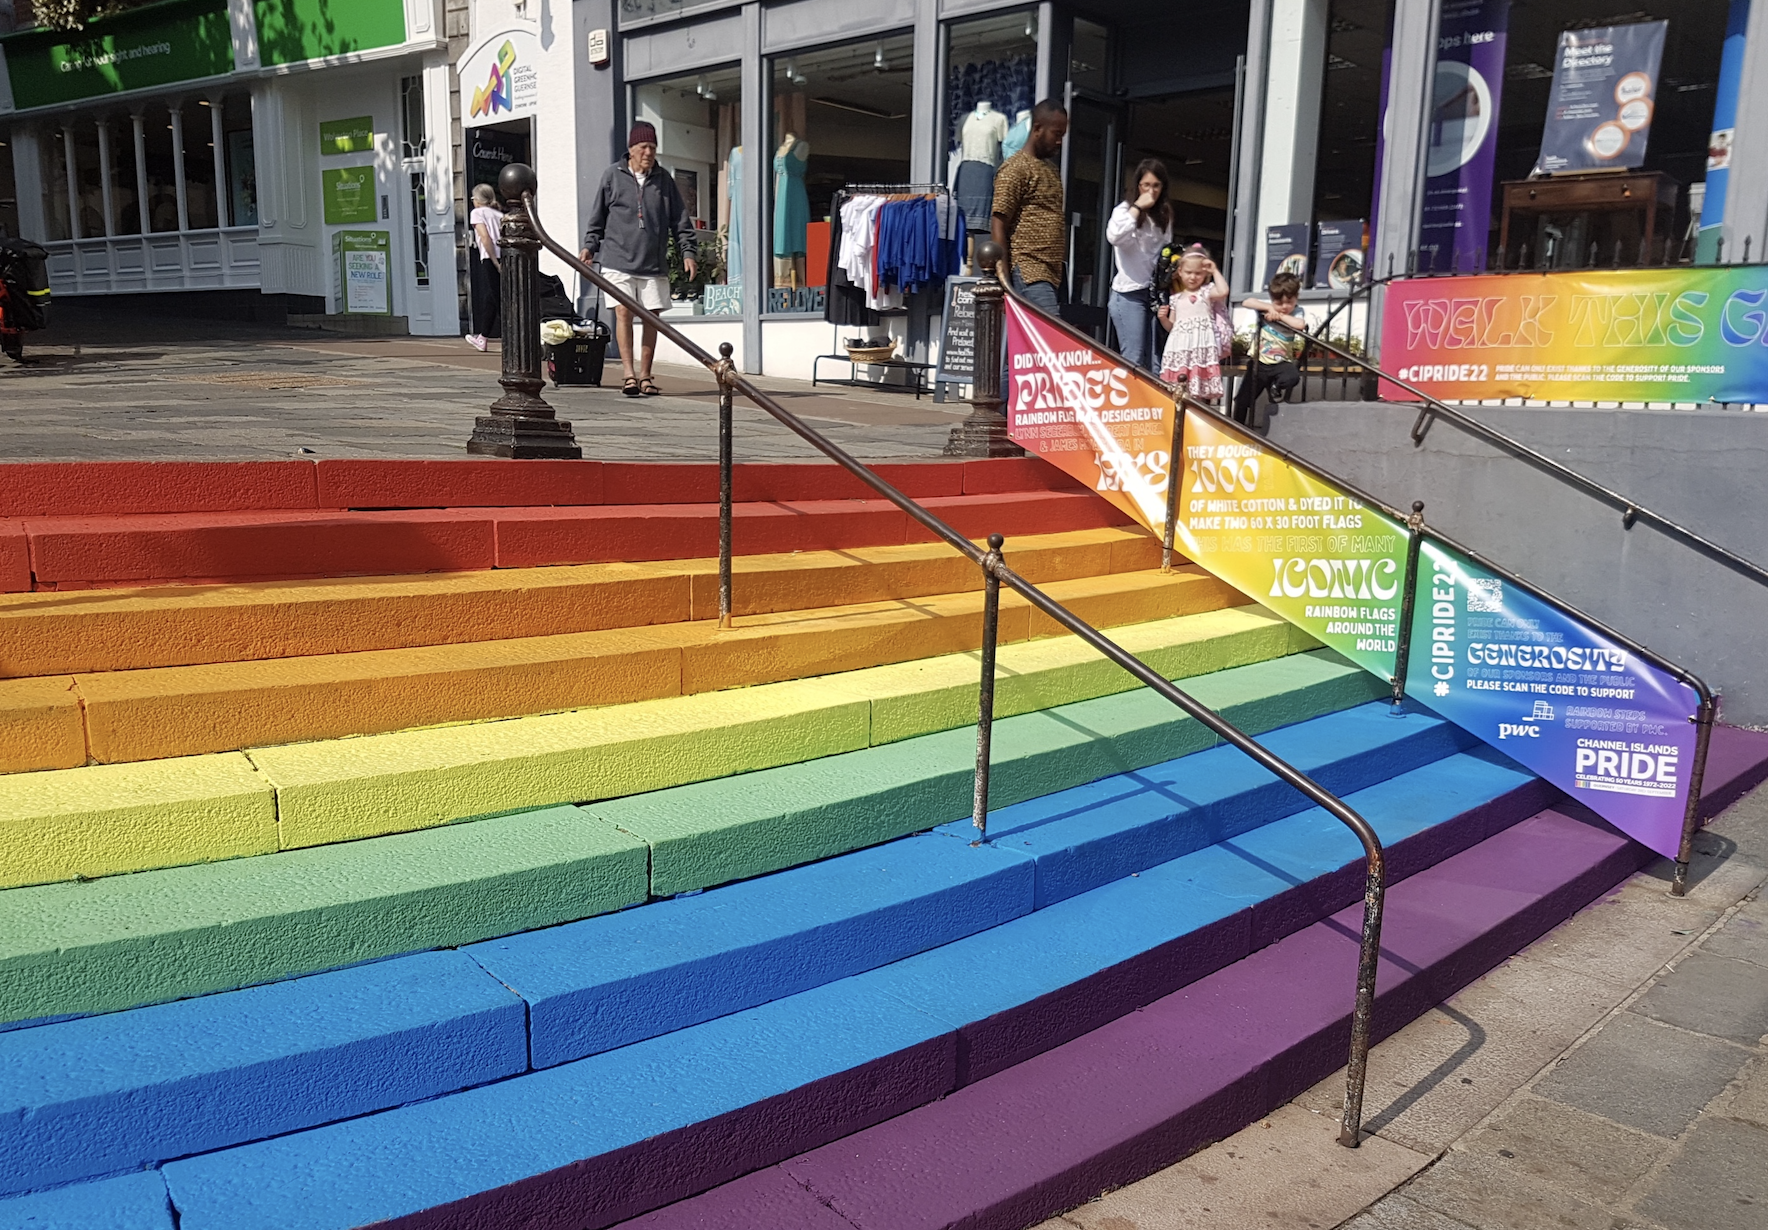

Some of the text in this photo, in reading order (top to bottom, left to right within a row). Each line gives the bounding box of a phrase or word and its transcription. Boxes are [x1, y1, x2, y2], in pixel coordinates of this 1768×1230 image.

[1562, 54, 1614, 68] Directory
[348, 262, 373, 270] SEEKING
[350, 270, 366, 278] NEW
[705, 286, 742, 310] BEACH
[1568, 290, 1710, 347] THIS
[1014, 354, 1033, 370] DID
[1058, 350, 1102, 368] KNOW...
[1398, 364, 1488, 382] #CIPRIDE22
[1496, 364, 1514, 372] PRIDE
[1516, 364, 1530, 372] CAN
[1567, 364, 1592, 372] THANKS
[1616, 365, 1658, 373] GENEROSITY
[1660, 365, 1670, 373] OF
[1670, 365, 1686, 373] OUR
[1687, 366, 1725, 374] SPONSORS
[1015, 367, 1130, 411] PRIDE'S
[1015, 412, 1057, 426] RAINBOW
[1102, 408, 1151, 422] DESIGNED
[1151, 408, 1164, 420] BY
[1040, 440, 1048, 452] &
[1050, 438, 1078, 452] JAMES
[1134, 438, 1145, 450] IN
[1188, 446, 1214, 459] THEY
[1190, 458, 1260, 493] 1000
[1190, 496, 1363, 512] OF WHITE COTTON & DYED IT TO
[1190, 515, 1362, 530] MAKE TWO 60 X 30 FOOT FLAGS
[1222, 536, 1252, 553] WAS
[1256, 536, 1284, 552] THE
[1286, 536, 1324, 552] FIRST
[1326, 535, 1348, 552] OF
[1351, 535, 1396, 553] MANY
[1269, 558, 1398, 600] ICONIC
[1305, 605, 1396, 620] RAINBOW FLAGS
[1326, 622, 1395, 636] AROUND THE
[1431, 560, 1457, 697] #CIPRIDE22
[1467, 616, 1540, 630] PRIDE CAN ONLY
[1467, 629, 1564, 642] EXIST THANKS TO THE
[1356, 638, 1396, 652] WORLD
[1467, 642, 1628, 672] GENEROSITY
[1467, 668, 1636, 687] OF OUR SPONSORS AND THE PUBLIC
[1466, 680, 1635, 700] PLEASE SCAN THE CODE TO SUPPORT
[1566, 706, 1646, 722] RAINBOW STEPS
[1498, 723, 1540, 740] pwc
[1564, 718, 1624, 732] SUPPORTED
[1626, 722, 1639, 734] BY
[1576, 738, 1678, 756] CHANNEL ISLANDS
[1576, 748, 1678, 783] PRIDE
[1575, 774, 1614, 783] CELEBRATING
[1624, 778, 1642, 786] YEARS
[1642, 780, 1676, 789] 1972-2022
